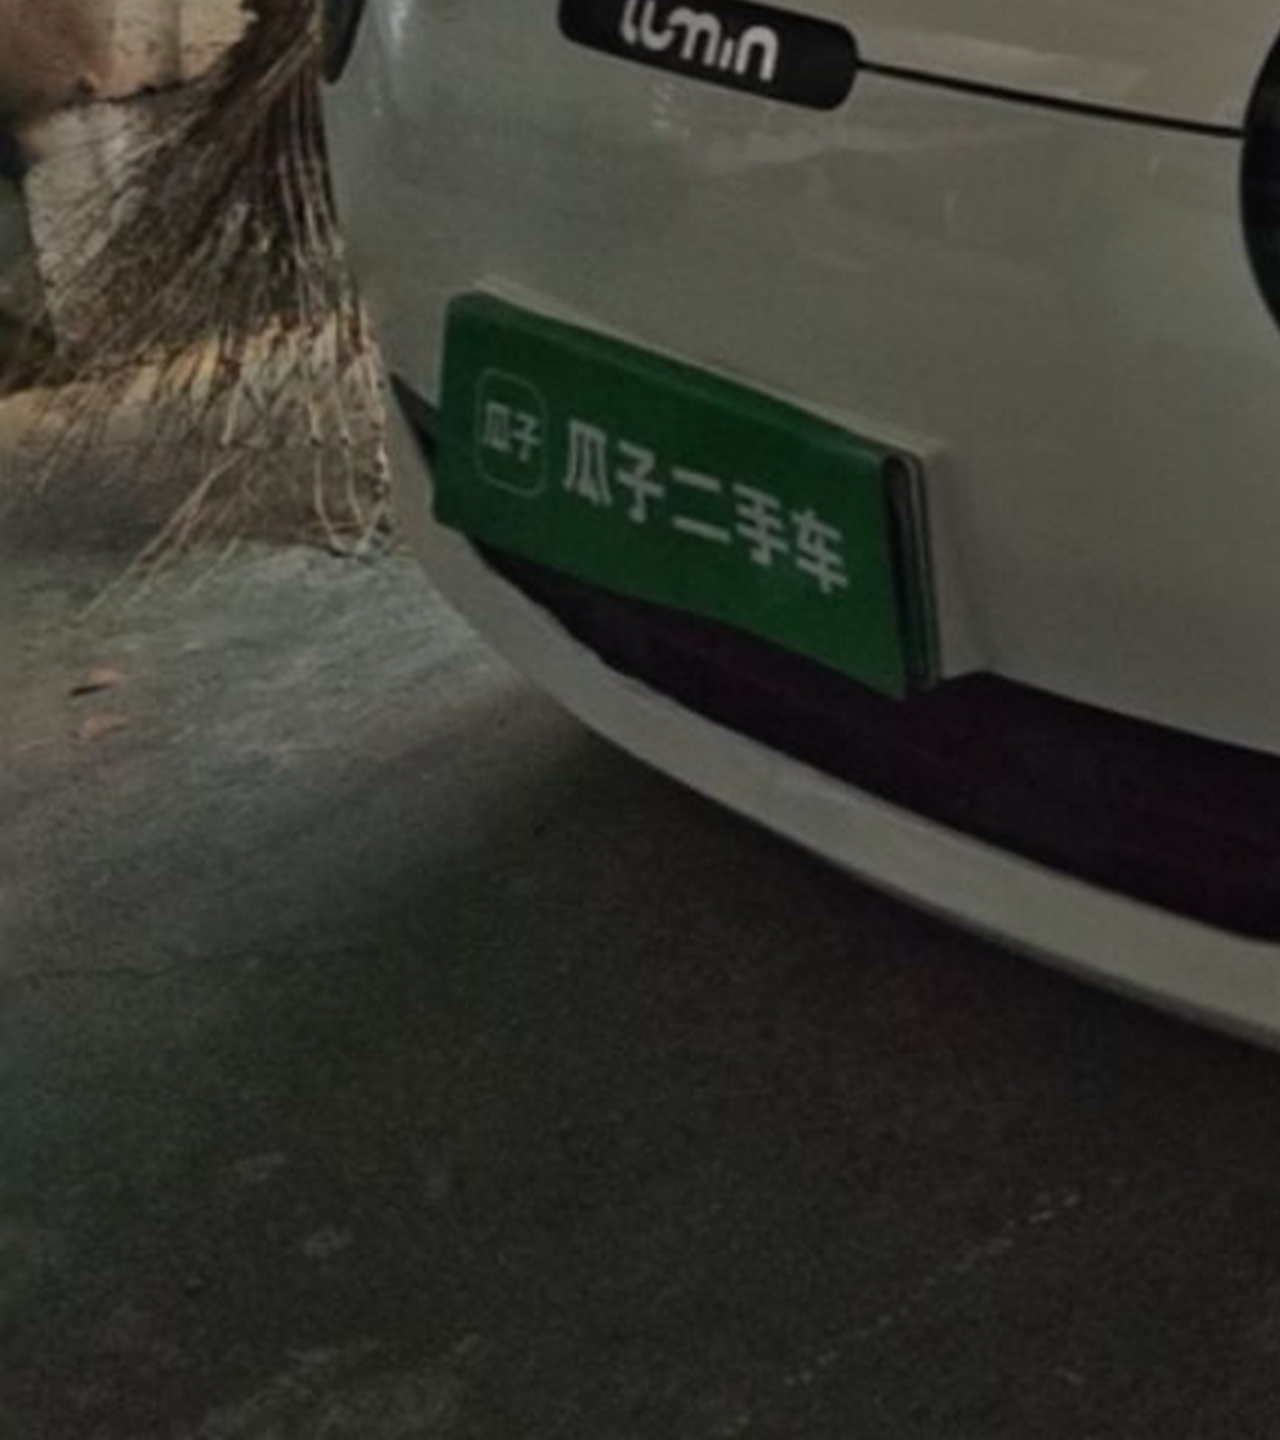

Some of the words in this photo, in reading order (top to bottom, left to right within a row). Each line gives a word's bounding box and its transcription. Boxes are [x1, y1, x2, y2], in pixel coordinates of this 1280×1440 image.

[562, 418, 850, 594] 瓜子二手车
